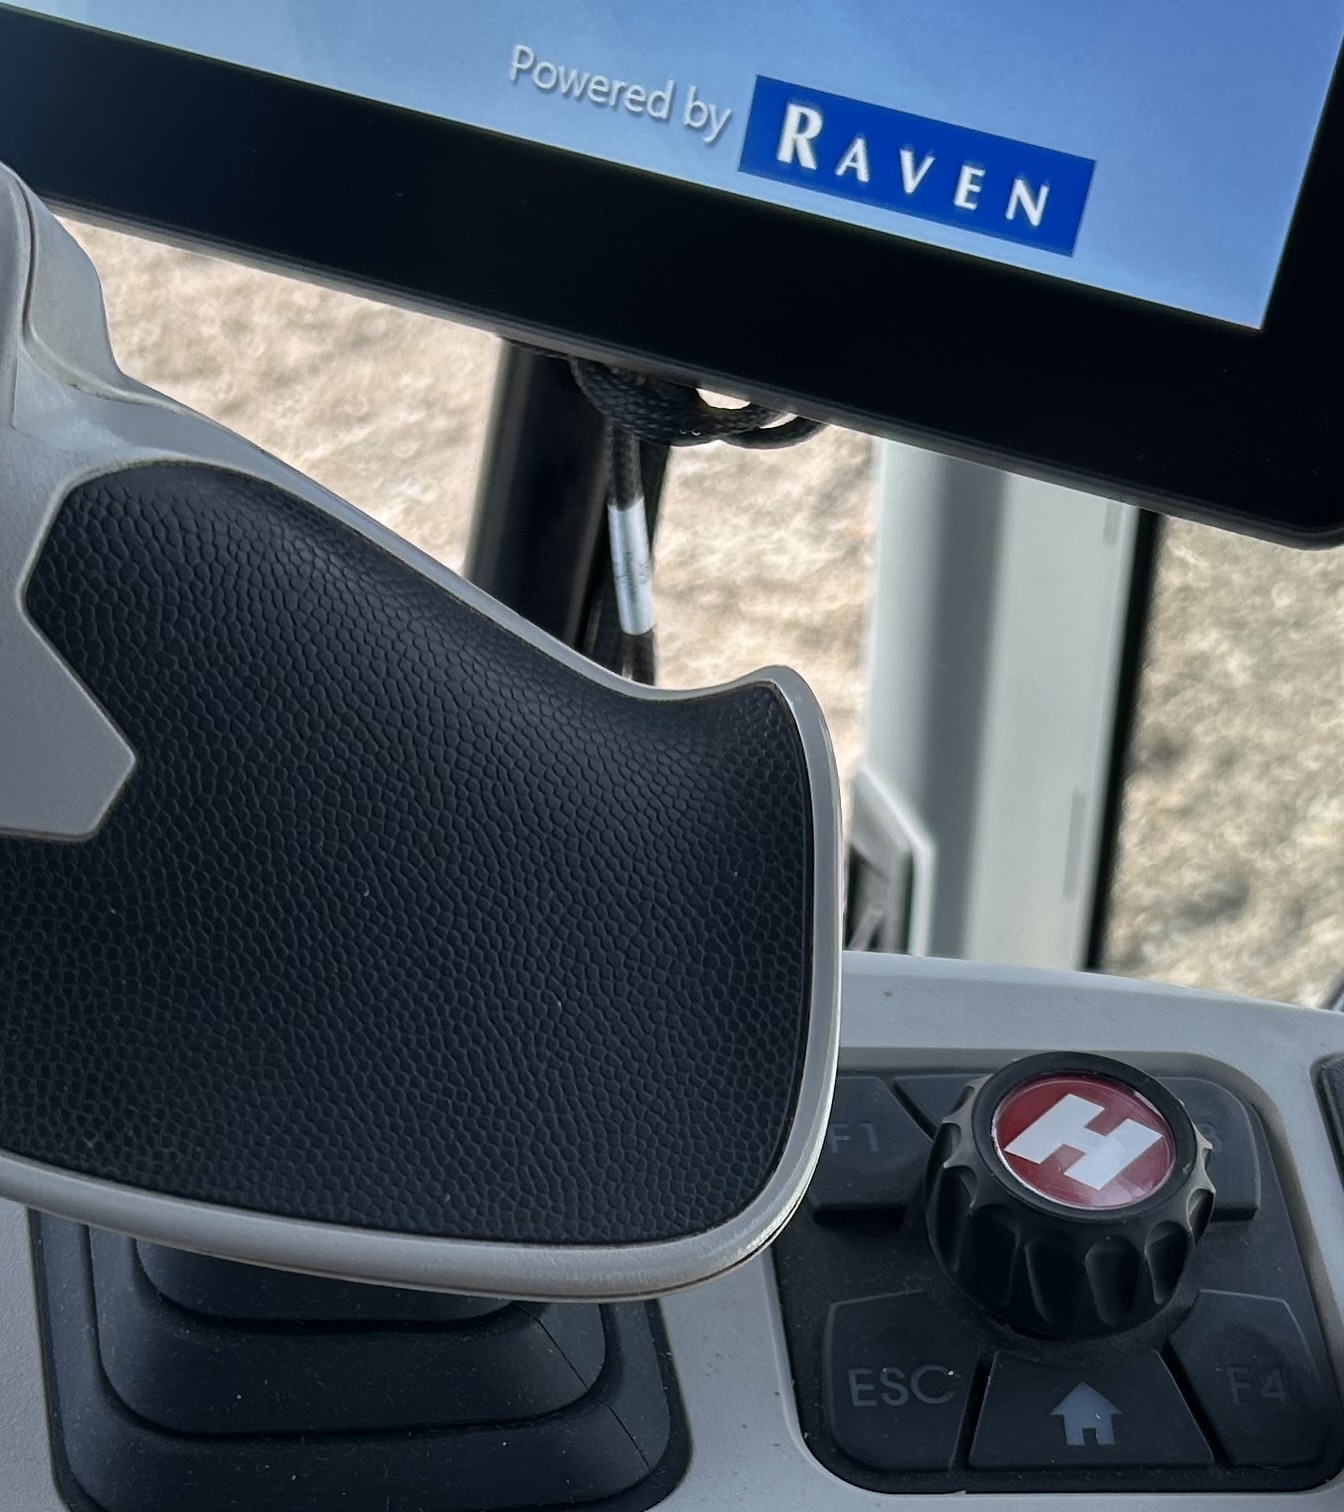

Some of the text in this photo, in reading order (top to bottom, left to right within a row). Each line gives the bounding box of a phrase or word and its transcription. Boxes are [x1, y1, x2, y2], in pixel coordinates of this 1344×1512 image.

[510, 44, 1051, 227] Powered by RAVEN
[830, 1121, 880, 1153] F1
[847, 1364, 956, 1407] ESC
[1226, 1366, 1288, 1406] F4
